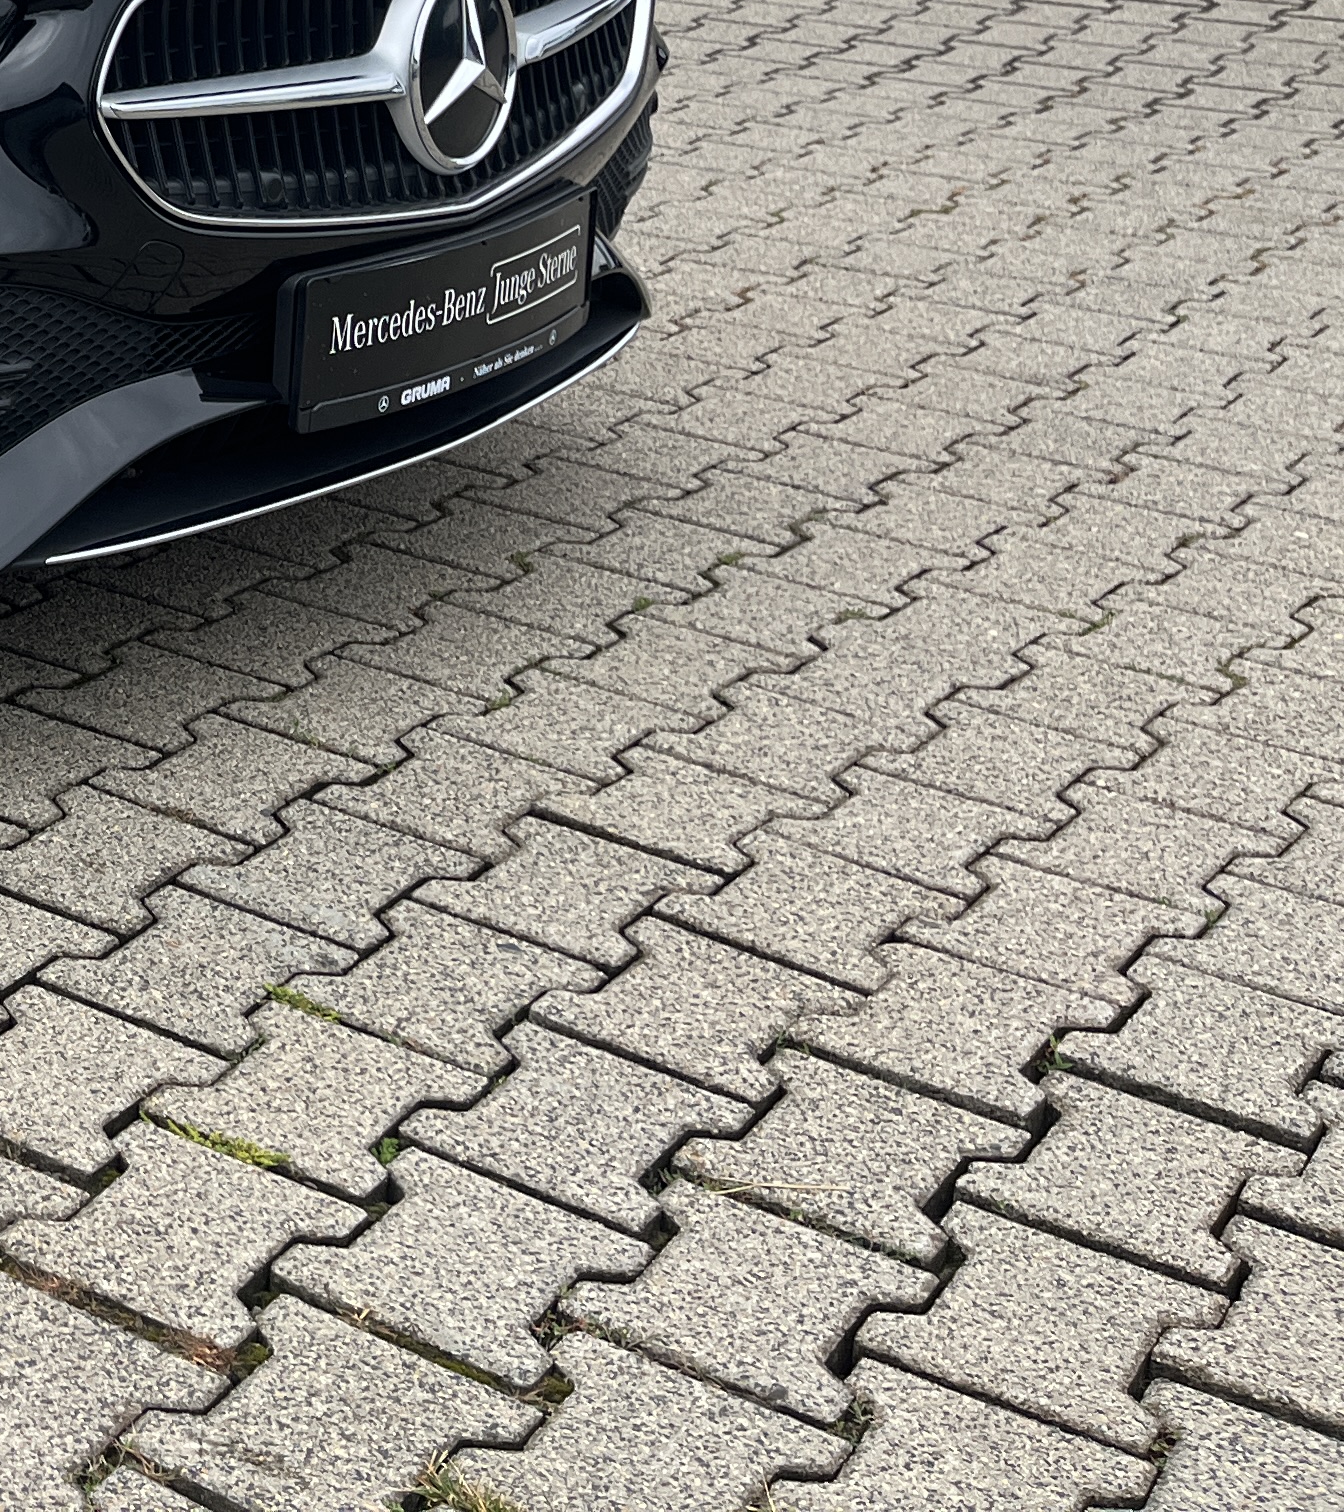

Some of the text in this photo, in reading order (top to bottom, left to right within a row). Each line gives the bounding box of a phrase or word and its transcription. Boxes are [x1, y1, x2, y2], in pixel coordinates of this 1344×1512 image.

[329, 245, 577, 355] Mercedes-Benz Junge Sterne
[401, 376, 451, 405] GRUMA
